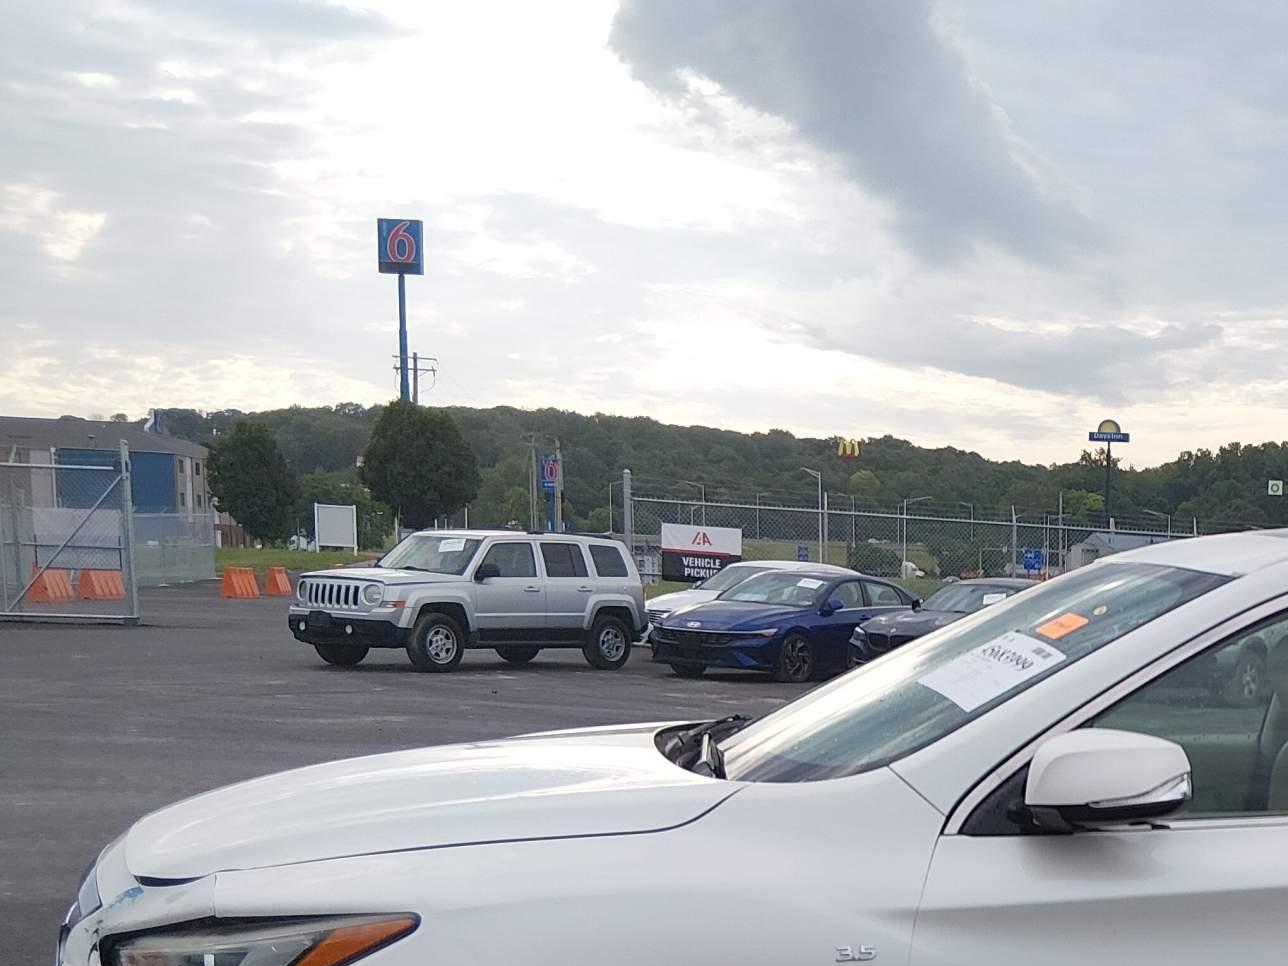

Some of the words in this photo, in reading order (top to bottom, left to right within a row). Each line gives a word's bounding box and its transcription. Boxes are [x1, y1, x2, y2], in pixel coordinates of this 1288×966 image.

[387, 221, 416, 263] 6
[682, 556, 721, 569] VEHICLE
[834, 945, 878, 963] 3.5
